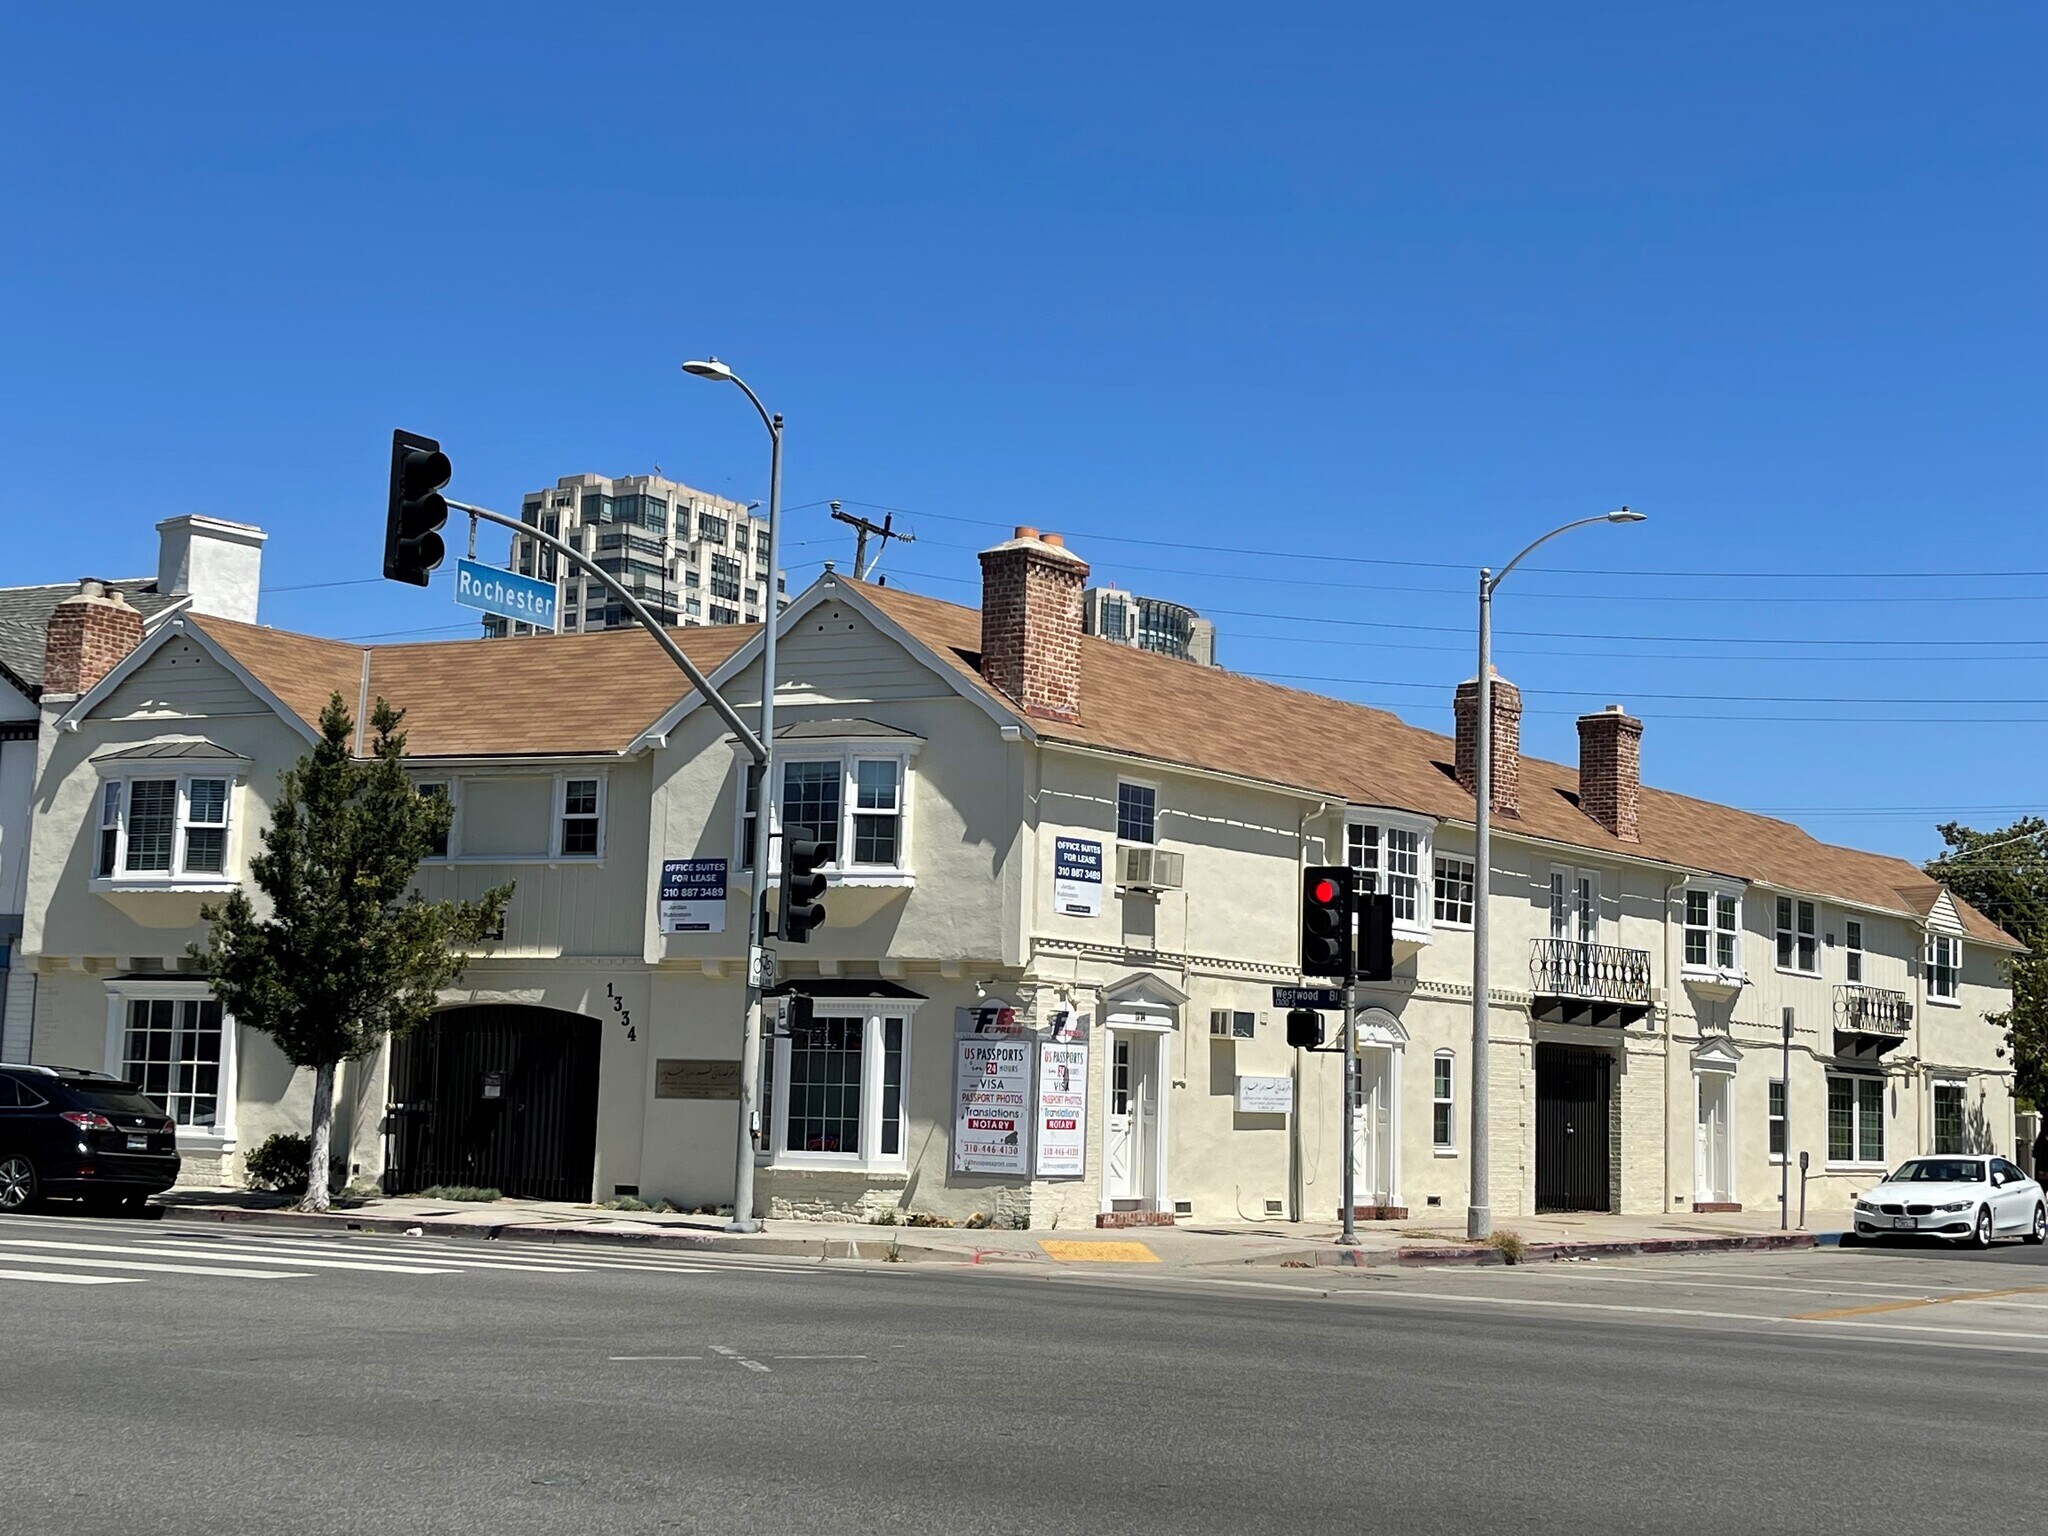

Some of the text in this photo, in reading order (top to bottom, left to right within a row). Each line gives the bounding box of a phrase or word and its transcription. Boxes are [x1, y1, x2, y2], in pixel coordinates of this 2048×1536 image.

[460, 570, 552, 615] Rochester
[1057, 841, 1101, 854] OFFICE SUITES
[1063, 853, 1097, 864] FOR LEASE
[665, 863, 725, 872] OFFICE SUITES
[1058, 866, 1101, 880] 310 887 3489
[671, 874, 717, 882] FOR LEASE
[663, 887, 724, 897] 310 887 3489
[1275, 988, 1319, 1001] Westwood
[607, 982, 637, 1042] 1334
[964, 1047, 1024, 1061] US PASSPORTS
[1045, 1050, 1084, 1064] US PASSPORTS
[986, 1063, 997, 1075] 24
[980, 1079, 1005, 1089] VISA
[962, 1093, 1023, 1104] PASSPORT PHOTOS
[1042, 1095, 1082, 1105] PASSPORT PHOTOS
[965, 1107, 1019, 1118] Translations
[1044, 1107, 1080, 1118] Translations
[972, 1120, 1010, 1129] NOTARY
[1049, 1120, 1074, 1129] NOTARY
